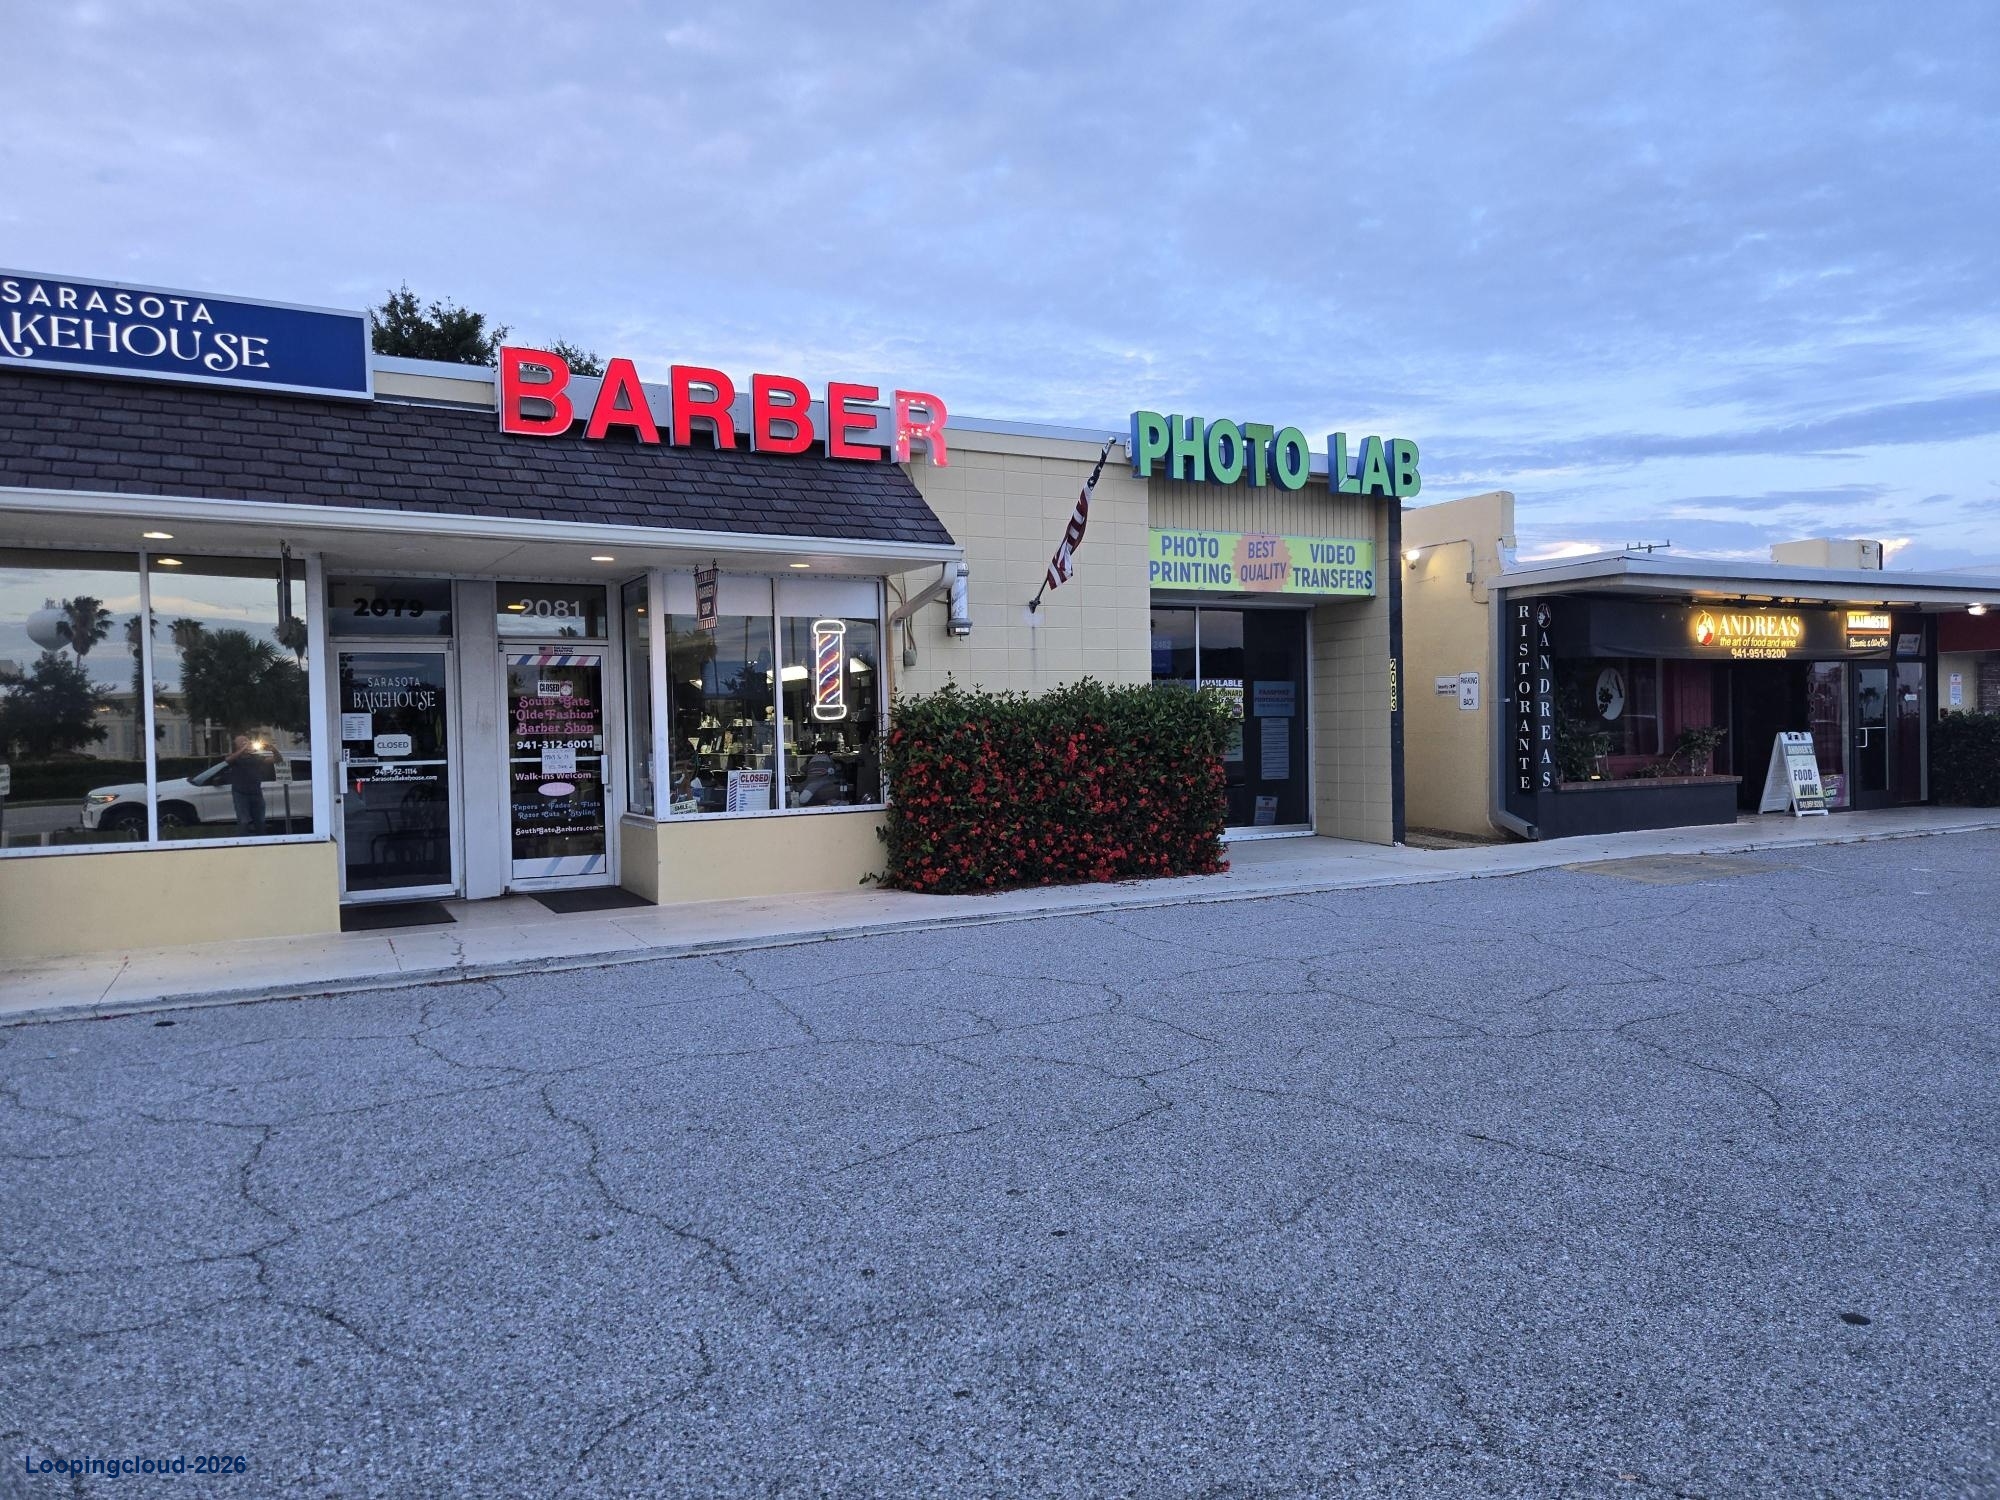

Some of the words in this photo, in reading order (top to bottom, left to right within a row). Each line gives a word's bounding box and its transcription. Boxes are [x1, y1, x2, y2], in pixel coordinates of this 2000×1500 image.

[1, 280, 214, 325] SARASOTA
[499, 345, 949, 468] BARBER
[1130, 411, 1311, 491] PHOTO
[1327, 431, 1422, 498] LAB
[1161, 535, 1219, 559] PHOTO
[1248, 540, 1276, 559] BEST
[1310, 543, 1356, 565] VIDEO
[1150, 560, 1232, 585] PRINTING
[1240, 562, 1287, 583] QUALITY
[1292, 566, 1373, 590] TRANSFERS
[353, 598, 425, 618] 2079
[519, 598, 582, 619] 2081
[1718, 614, 1801, 637] ANDREA'S
[1720, 637, 1731, 646] the
[1732, 638, 1742, 646] art
[1742, 637, 1751, 647] of
[1751, 637, 1766, 647] food
[1767, 638, 1780, 647] and
[1781, 640, 1797, 648] wine
[1731, 648, 1787, 659] 941-951-9200
[367, 677, 421, 688] SARASOTA
[539, 683, 560, 692] CLOSED
[1201, 679, 1243, 687] AVAILABLE
[353, 691, 436, 714] BAKEHOUSE
[519, 696, 555, 709] South
[559, 695, 590, 709] Gate
[1518, 605, 1531, 790] RISTORANTE
[1539, 631, 1552, 788] ANDREAS
[516, 722, 560, 736] Barber
[564, 721, 595, 735] Shop
[376, 741, 409, 749] CLOSED
[516, 740, 594, 750] 941-312-6001
[515, 773, 555, 781] Walk-ins
[740, 773, 769, 783] CLOSED
[1793, 769, 1813, 781] FOOD
[1799, 783, 1818, 796] WINE
